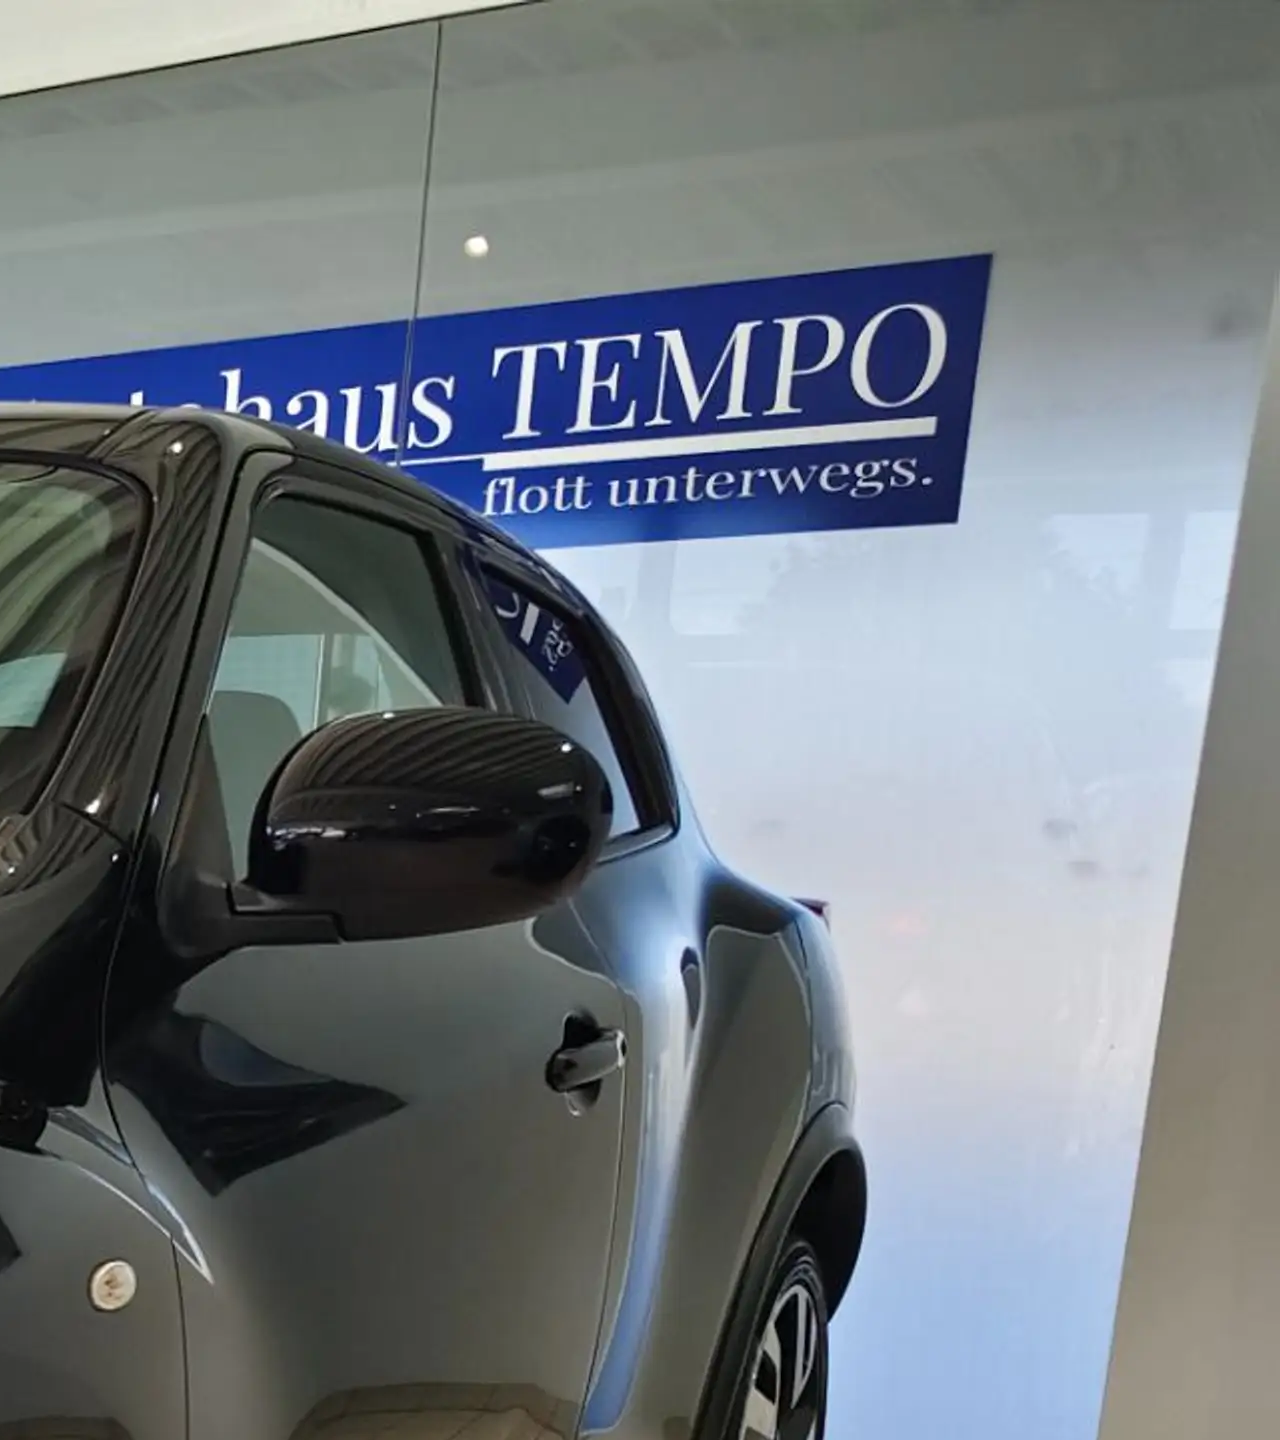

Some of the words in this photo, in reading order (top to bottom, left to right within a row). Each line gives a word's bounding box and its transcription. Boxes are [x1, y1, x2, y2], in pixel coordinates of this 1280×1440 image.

[491, 303, 948, 441] TEMPO
[482, 475, 593, 517] flott
[608, 456, 934, 507] unterwegs.
